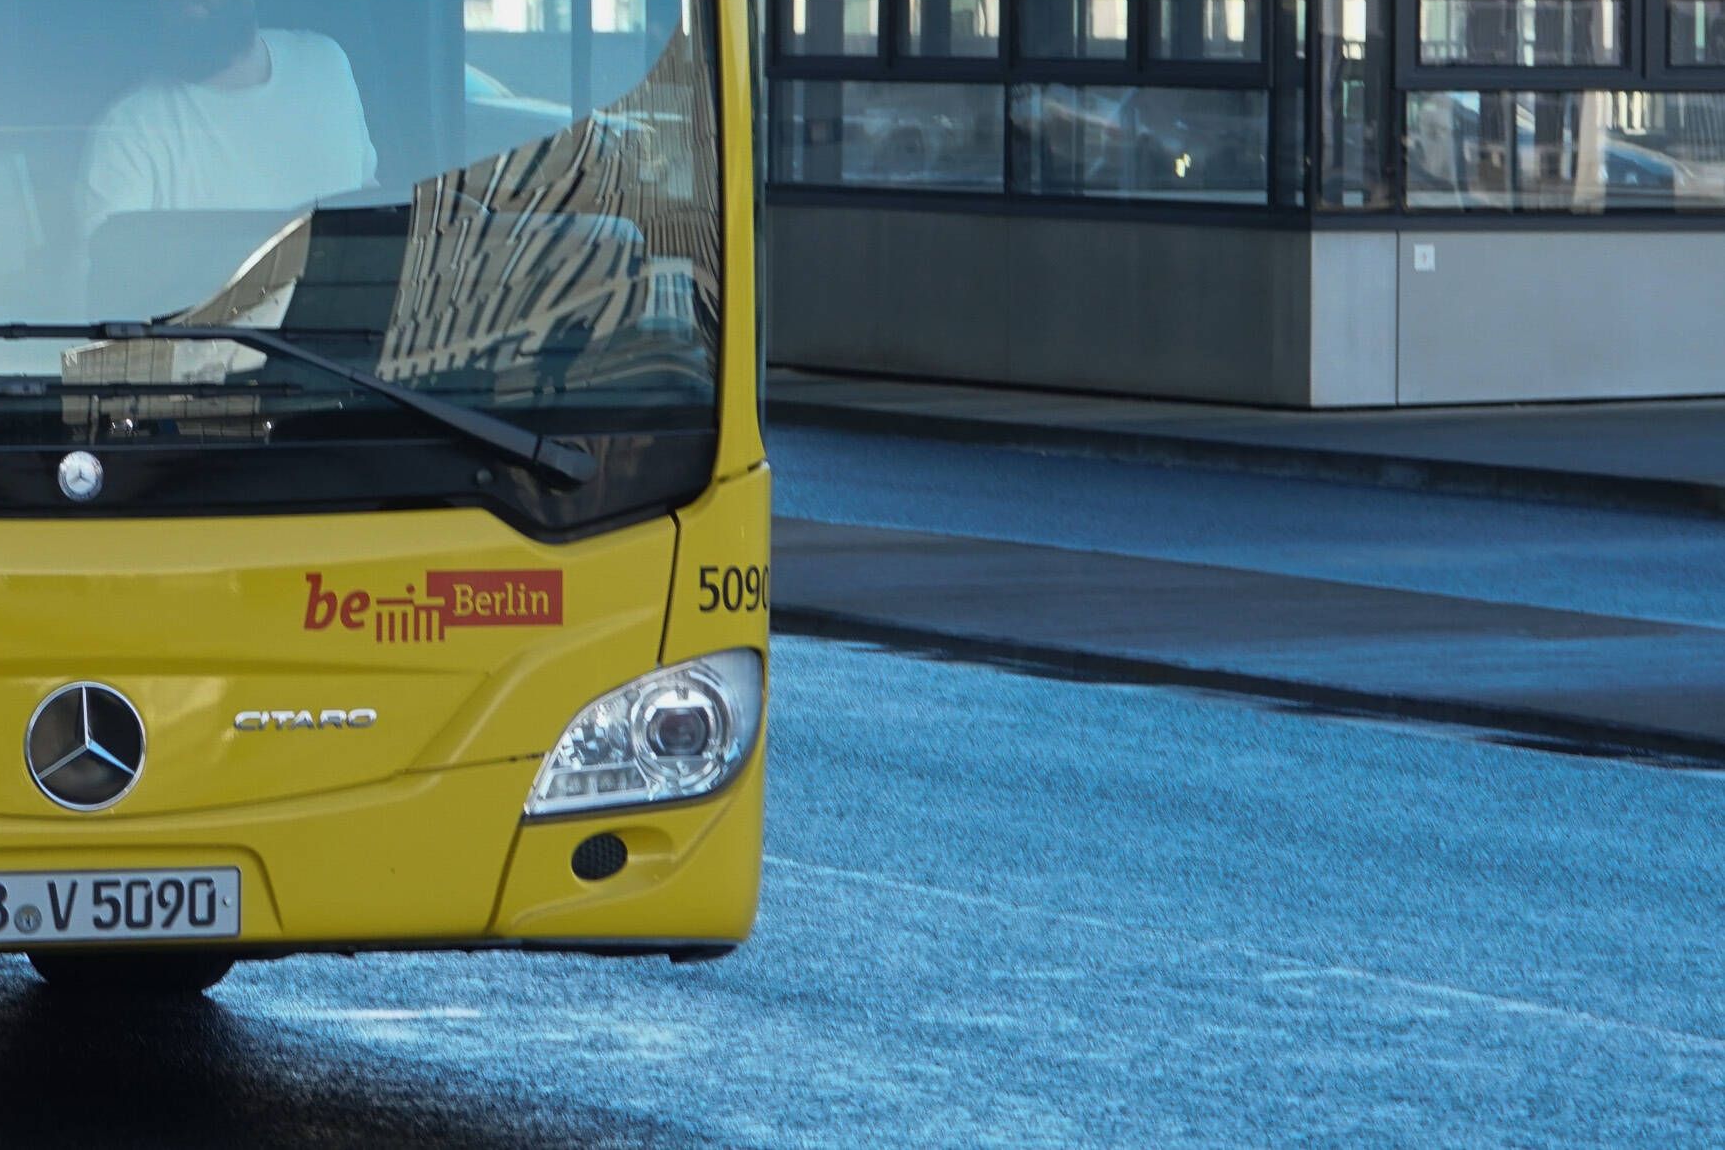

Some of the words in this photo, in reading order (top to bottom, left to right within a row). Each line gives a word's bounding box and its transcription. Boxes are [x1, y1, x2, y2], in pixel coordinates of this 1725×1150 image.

[304, 572, 371, 631] be
[452, 582, 550, 617] Berlin
[233, 708, 377, 731] CITARO
[47, 881, 78, 931] V
[92, 877, 217, 930] 5090
